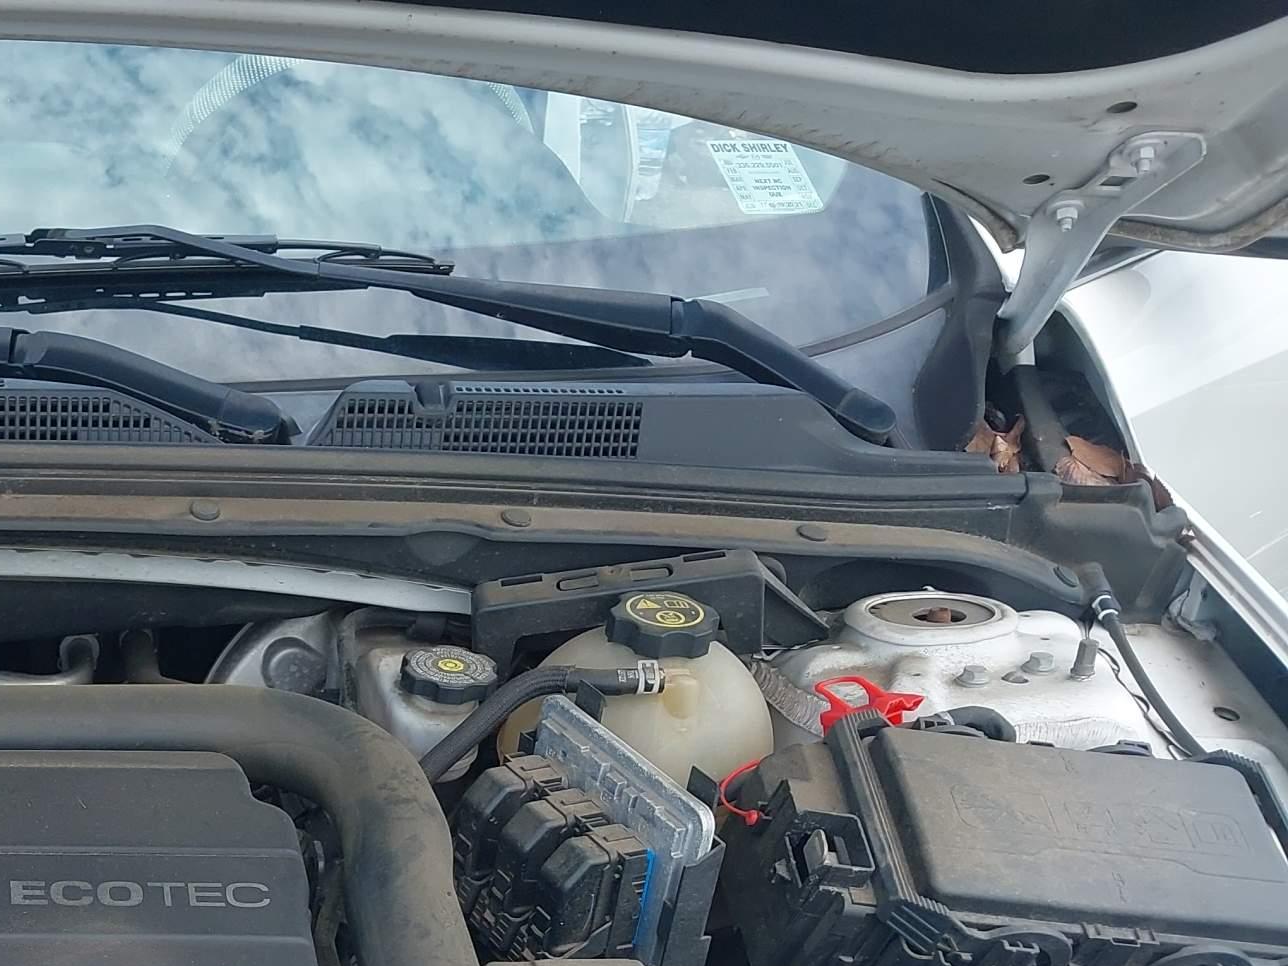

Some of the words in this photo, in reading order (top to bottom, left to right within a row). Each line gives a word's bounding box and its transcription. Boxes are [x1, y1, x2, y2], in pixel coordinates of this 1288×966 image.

[711, 143, 740, 153] DICK
[741, 143, 789, 153] SHIRLEY
[9, 880, 271, 908] ECOTEC
